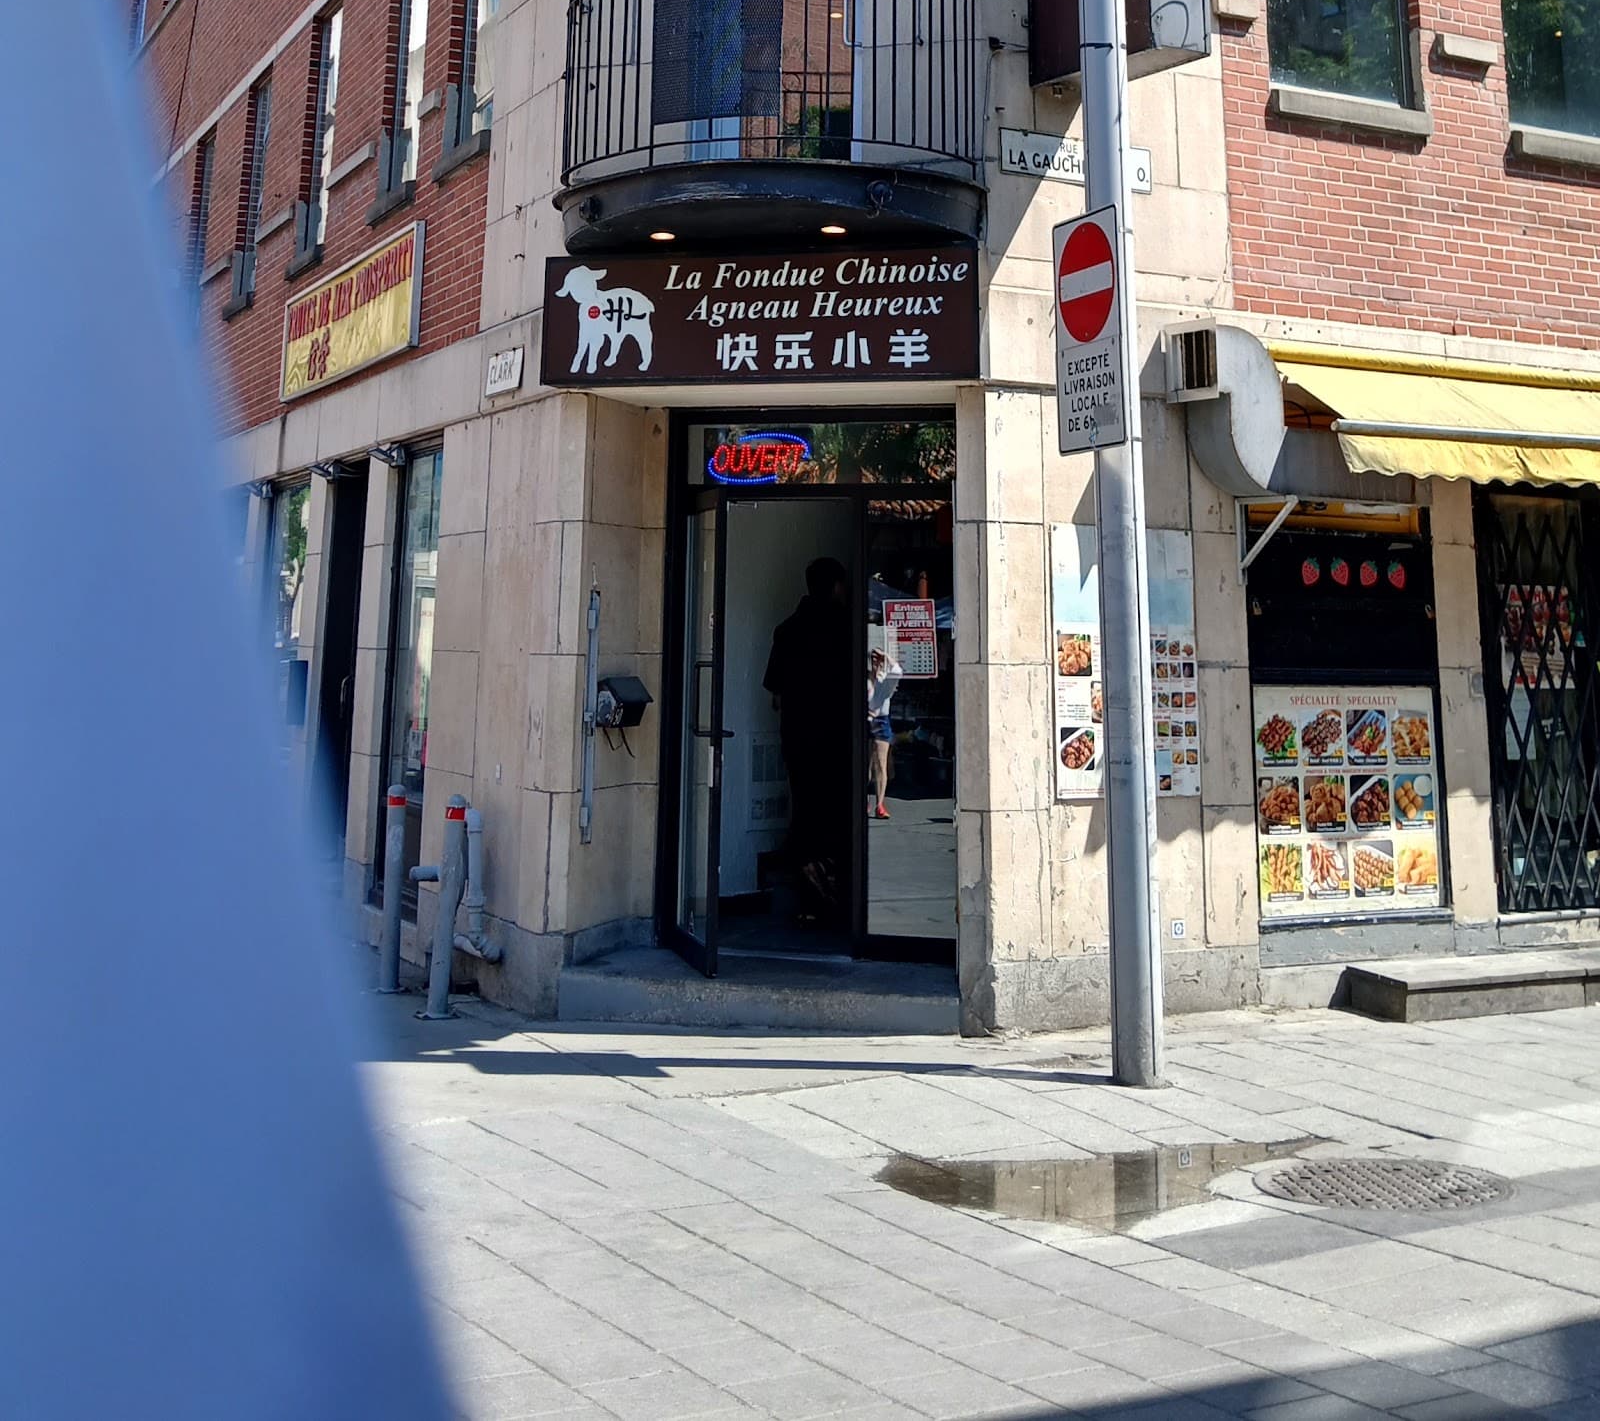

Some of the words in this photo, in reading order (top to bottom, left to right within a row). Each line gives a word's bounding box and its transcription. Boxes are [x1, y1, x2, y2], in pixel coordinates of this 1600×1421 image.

[1060, 142, 1078, 154] RUE
[1009, 149, 1028, 166] LA
[1032, 152, 1081, 175] GAUCH
[353, 238, 414, 311] PROSPERITY
[664, 265, 702, 290] La
[712, 262, 824, 290] Fondue
[835, 256, 968, 285] Chinoise
[686, 293, 799, 327] Agneau
[810, 291, 943, 318] Heureux
[716, 329, 931, 371] 快乐小羊
[1067, 348, 1110, 376] EXCEPTÉ
[489, 358, 514, 385] CLARK
[1063, 370, 1116, 396] LIVRAISON
[1071, 391, 1110, 413] LOCALE
[1068, 417, 1081, 433] DE
[713, 443, 805, 473] OUVERT
[887, 620, 933, 628] OUVERTS
